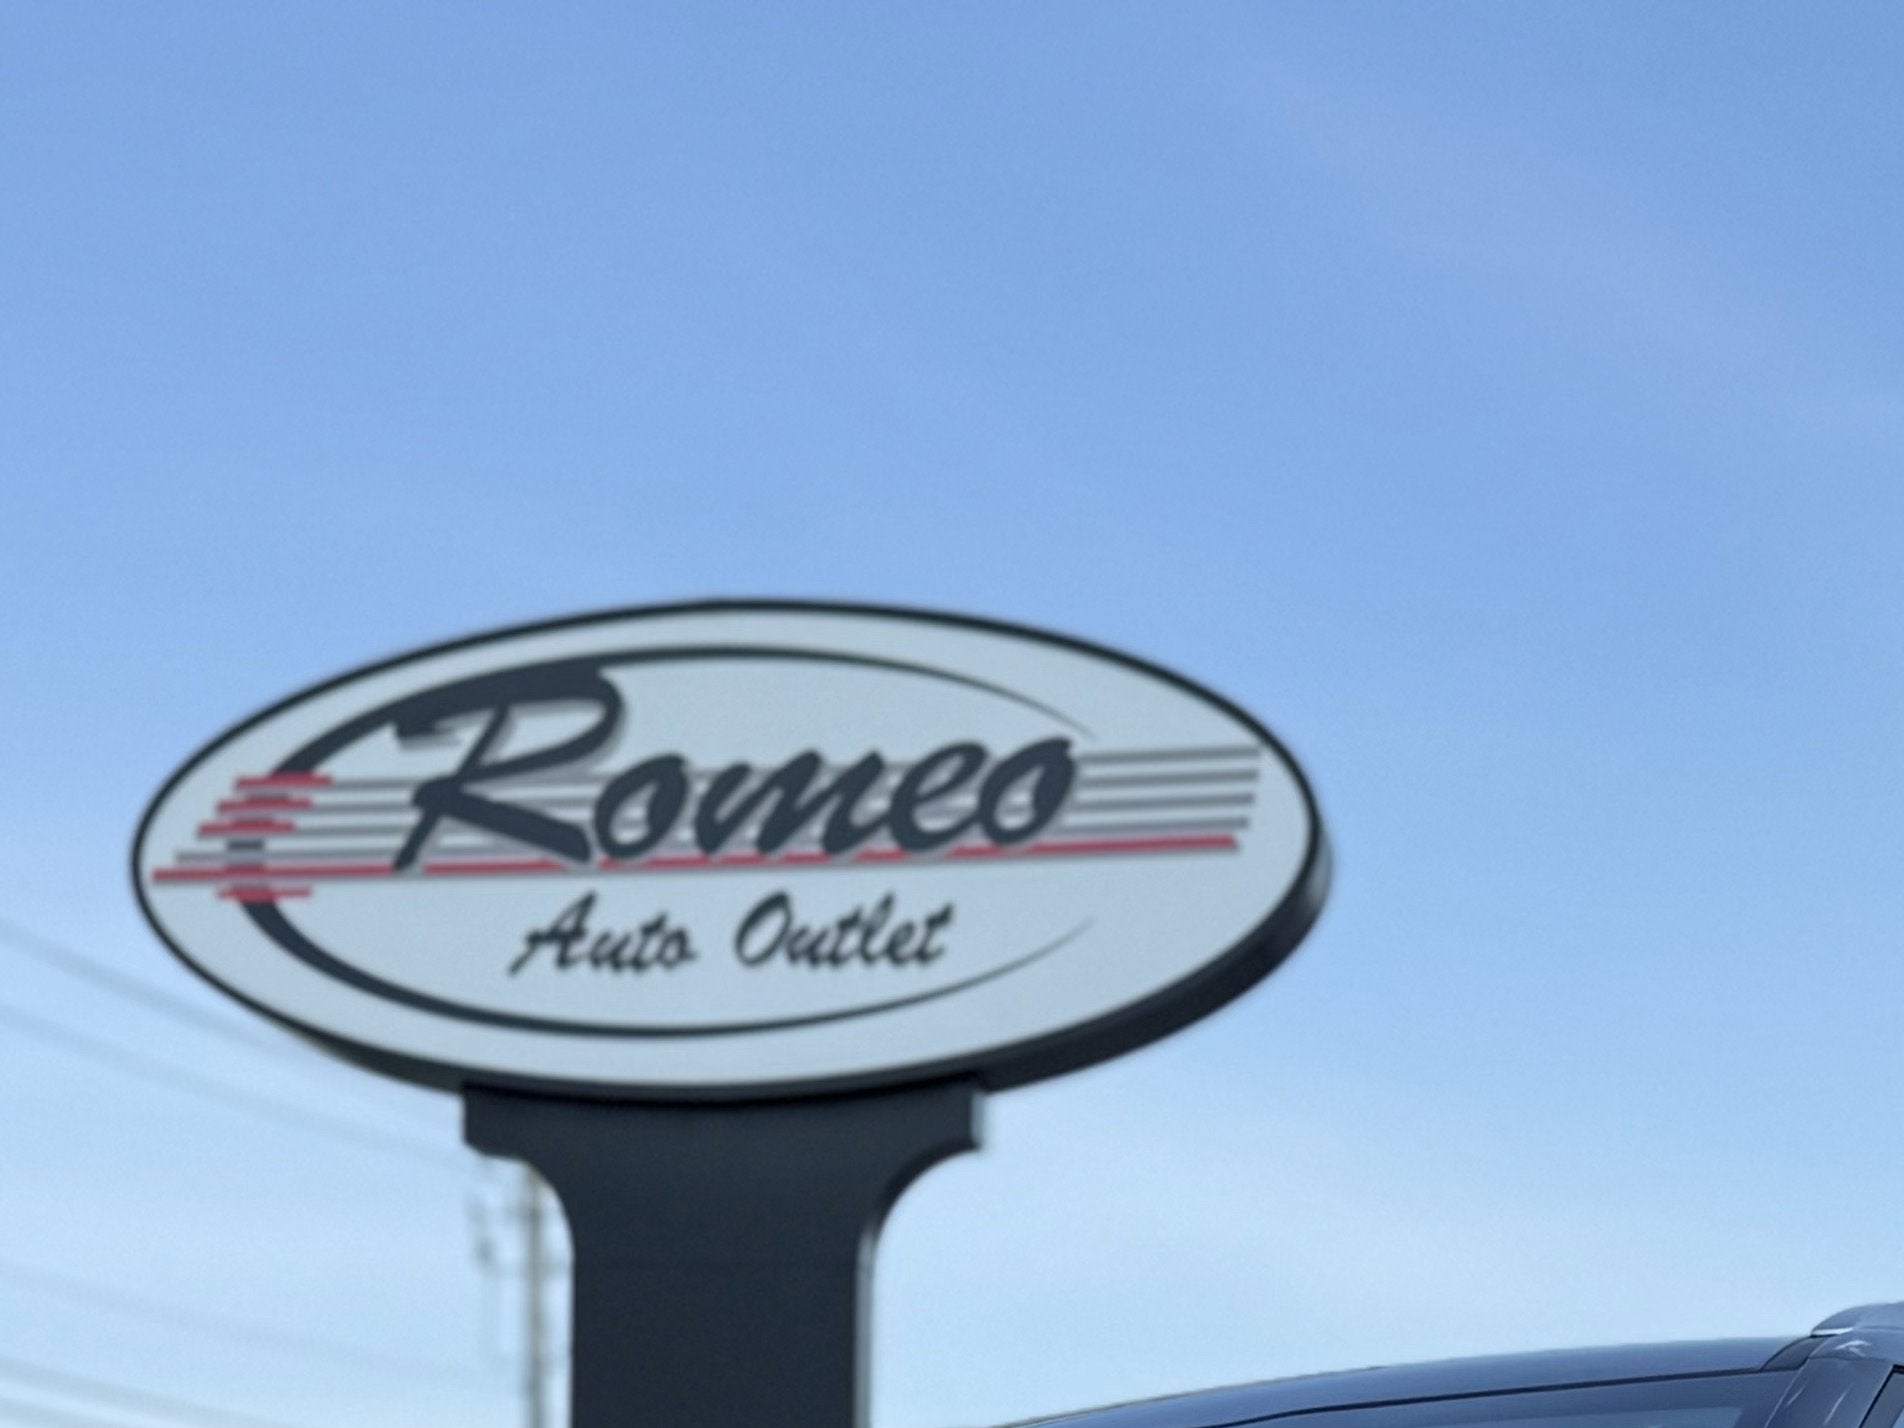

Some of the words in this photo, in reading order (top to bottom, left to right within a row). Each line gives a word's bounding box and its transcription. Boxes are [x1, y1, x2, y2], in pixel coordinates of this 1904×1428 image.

[390, 665, 1076, 872] Romeo
[508, 892, 698, 977] Auto
[735, 892, 954, 972] Outlet
